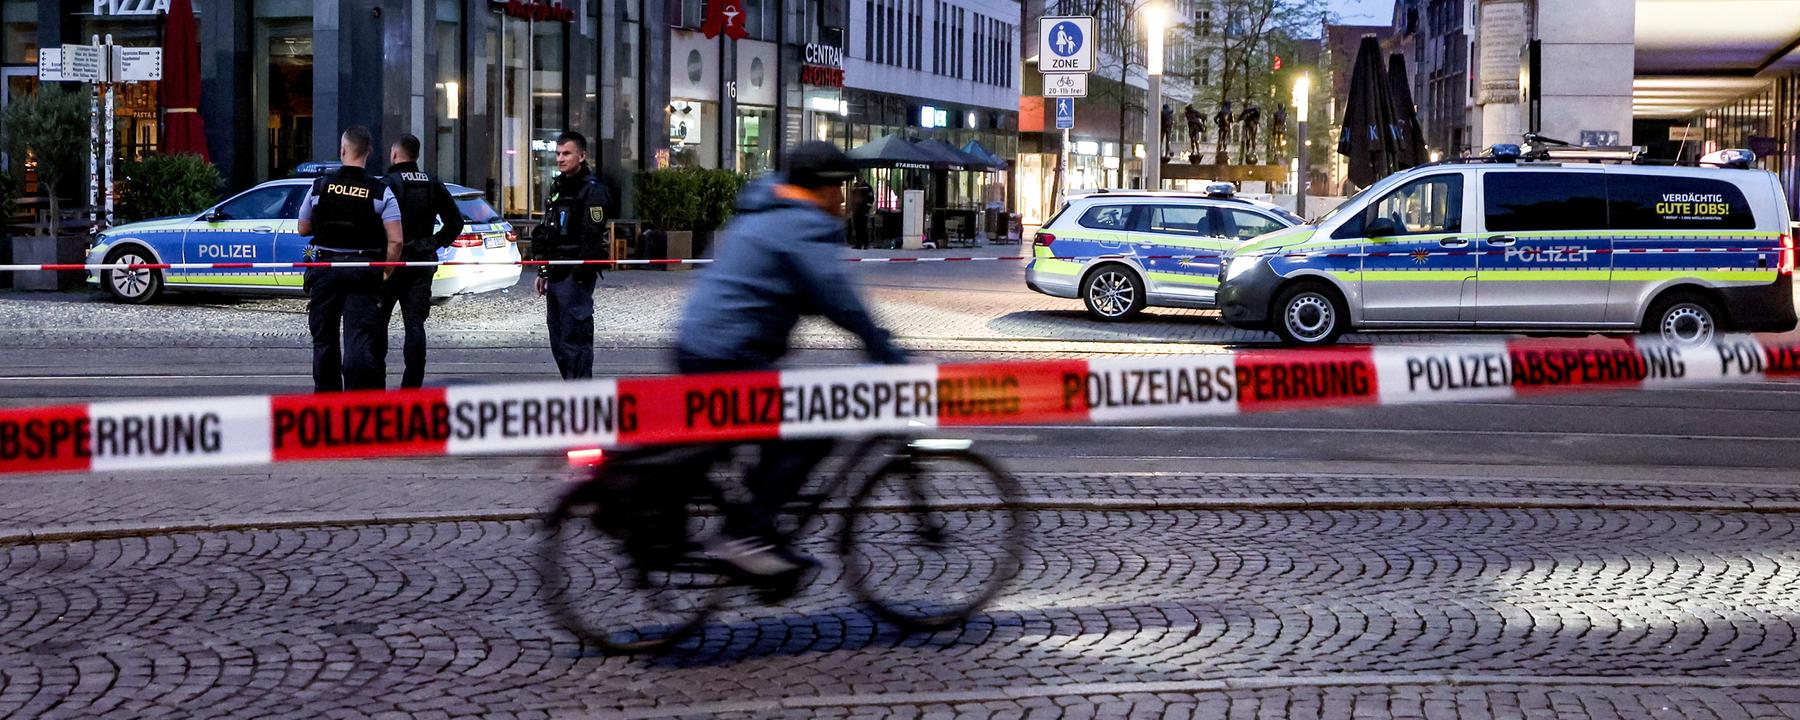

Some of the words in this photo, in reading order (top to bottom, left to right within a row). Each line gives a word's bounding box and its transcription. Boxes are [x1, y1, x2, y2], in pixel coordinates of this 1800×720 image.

[93, 0, 170, 16] PIZZA
[1052, 59, 1078, 68] ZONE
[726, 81, 736, 98] 16
[400, 172, 429, 182] POLIZEI
[327, 183, 370, 199] POLIZEI
[1662, 192, 1722, 203] VERDÄCHTIG
[1656, 202, 1691, 214] GUTE
[1694, 203, 1729, 215] JOBS!
[199, 244, 257, 258] POLIZEI
[1504, 246, 1588, 263] POLIZEI
[0, 412, 222, 460] BSPERRUNG
[273, 394, 638, 449] POLIZEIABSPERRUNG
[685, 375, 1020, 429] POLIZEIABSPERRUNG
[1062, 361, 1369, 411] POLIZEIABSPERRUNG
[1406, 345, 1685, 391] POLIZEIABSPERRUNG
